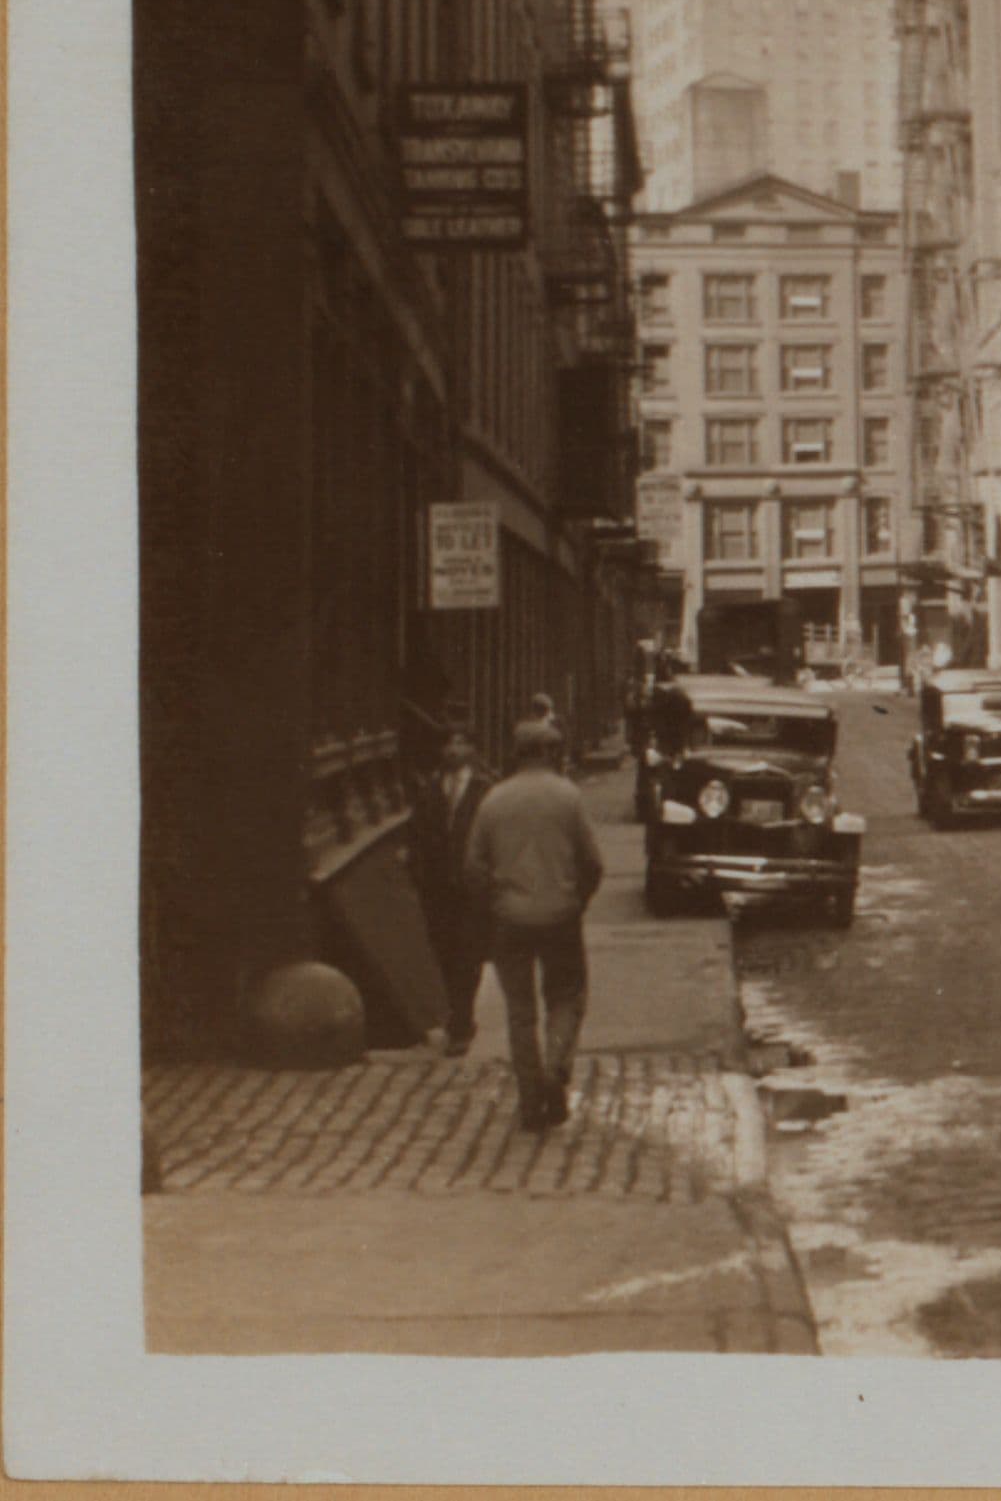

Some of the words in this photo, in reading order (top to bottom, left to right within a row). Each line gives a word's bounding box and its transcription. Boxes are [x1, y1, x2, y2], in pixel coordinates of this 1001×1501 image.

[445, 217, 523, 239] LEATHER
[436, 534, 455, 550] TO
[460, 533, 491, 550] LET
